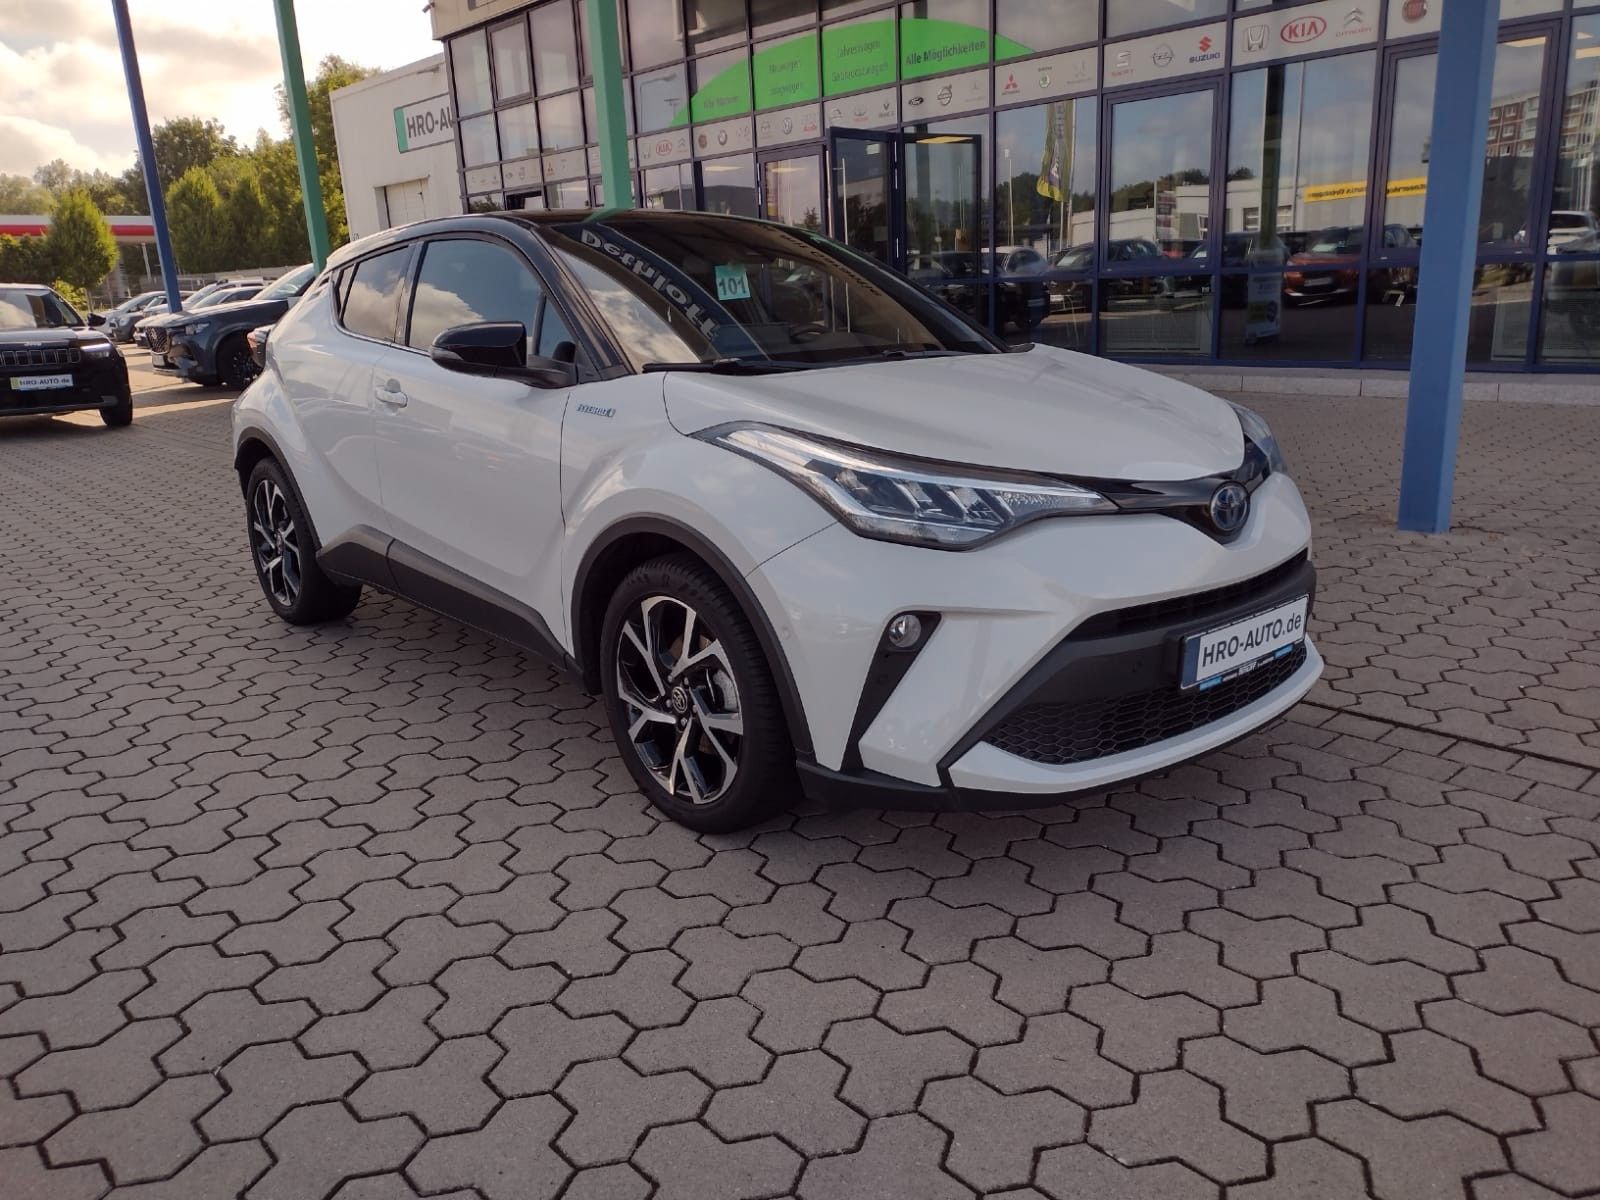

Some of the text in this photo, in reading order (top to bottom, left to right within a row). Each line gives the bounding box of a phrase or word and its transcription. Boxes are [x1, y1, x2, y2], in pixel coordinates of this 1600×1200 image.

[1288, 21, 1318, 39] KIA
[906, 52, 922, 65] Alle
[1189, 51, 1221, 63] SUZUKI
[718, 276, 748, 297] 101
[1202, 612, 1302, 668] HRO-AUTO.de
